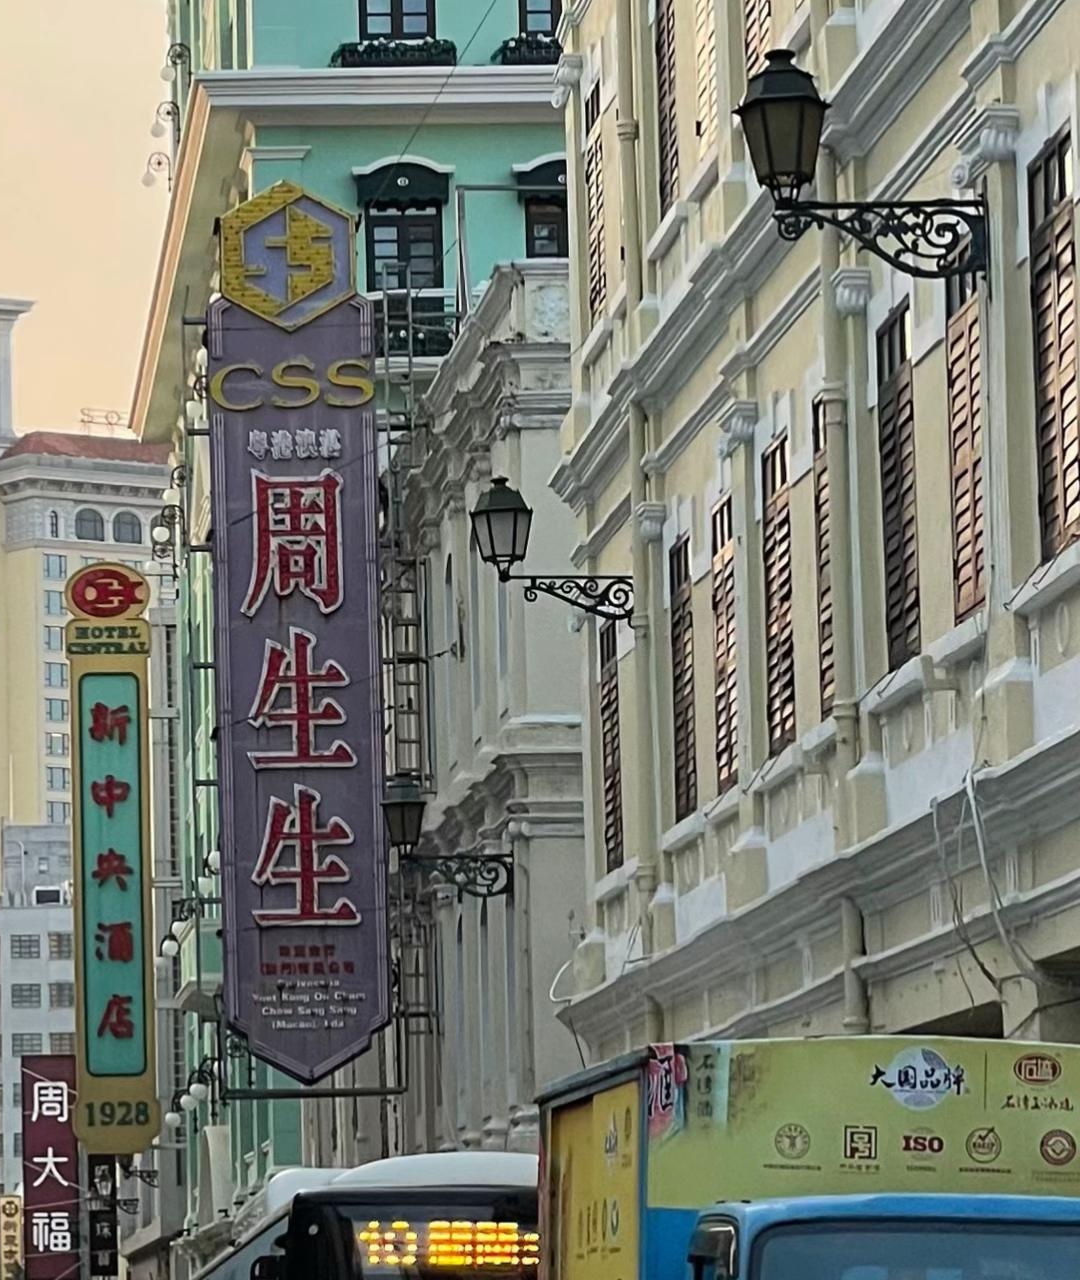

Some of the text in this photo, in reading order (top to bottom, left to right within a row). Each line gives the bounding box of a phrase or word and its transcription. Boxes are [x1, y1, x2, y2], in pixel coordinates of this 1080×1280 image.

[210, 358, 375, 411] CSS
[75, 626, 141, 639] HOTEL
[240, 468, 361, 927] 周生生
[88, 701, 133, 1040] 新中央酒店
[261, 1005, 357, 1017] Chow Sang Sang
[84, 1101, 149, 1127] 1928
[903, 1136, 943, 1152] ISO
[31, 1081, 70, 1252] 周大福
